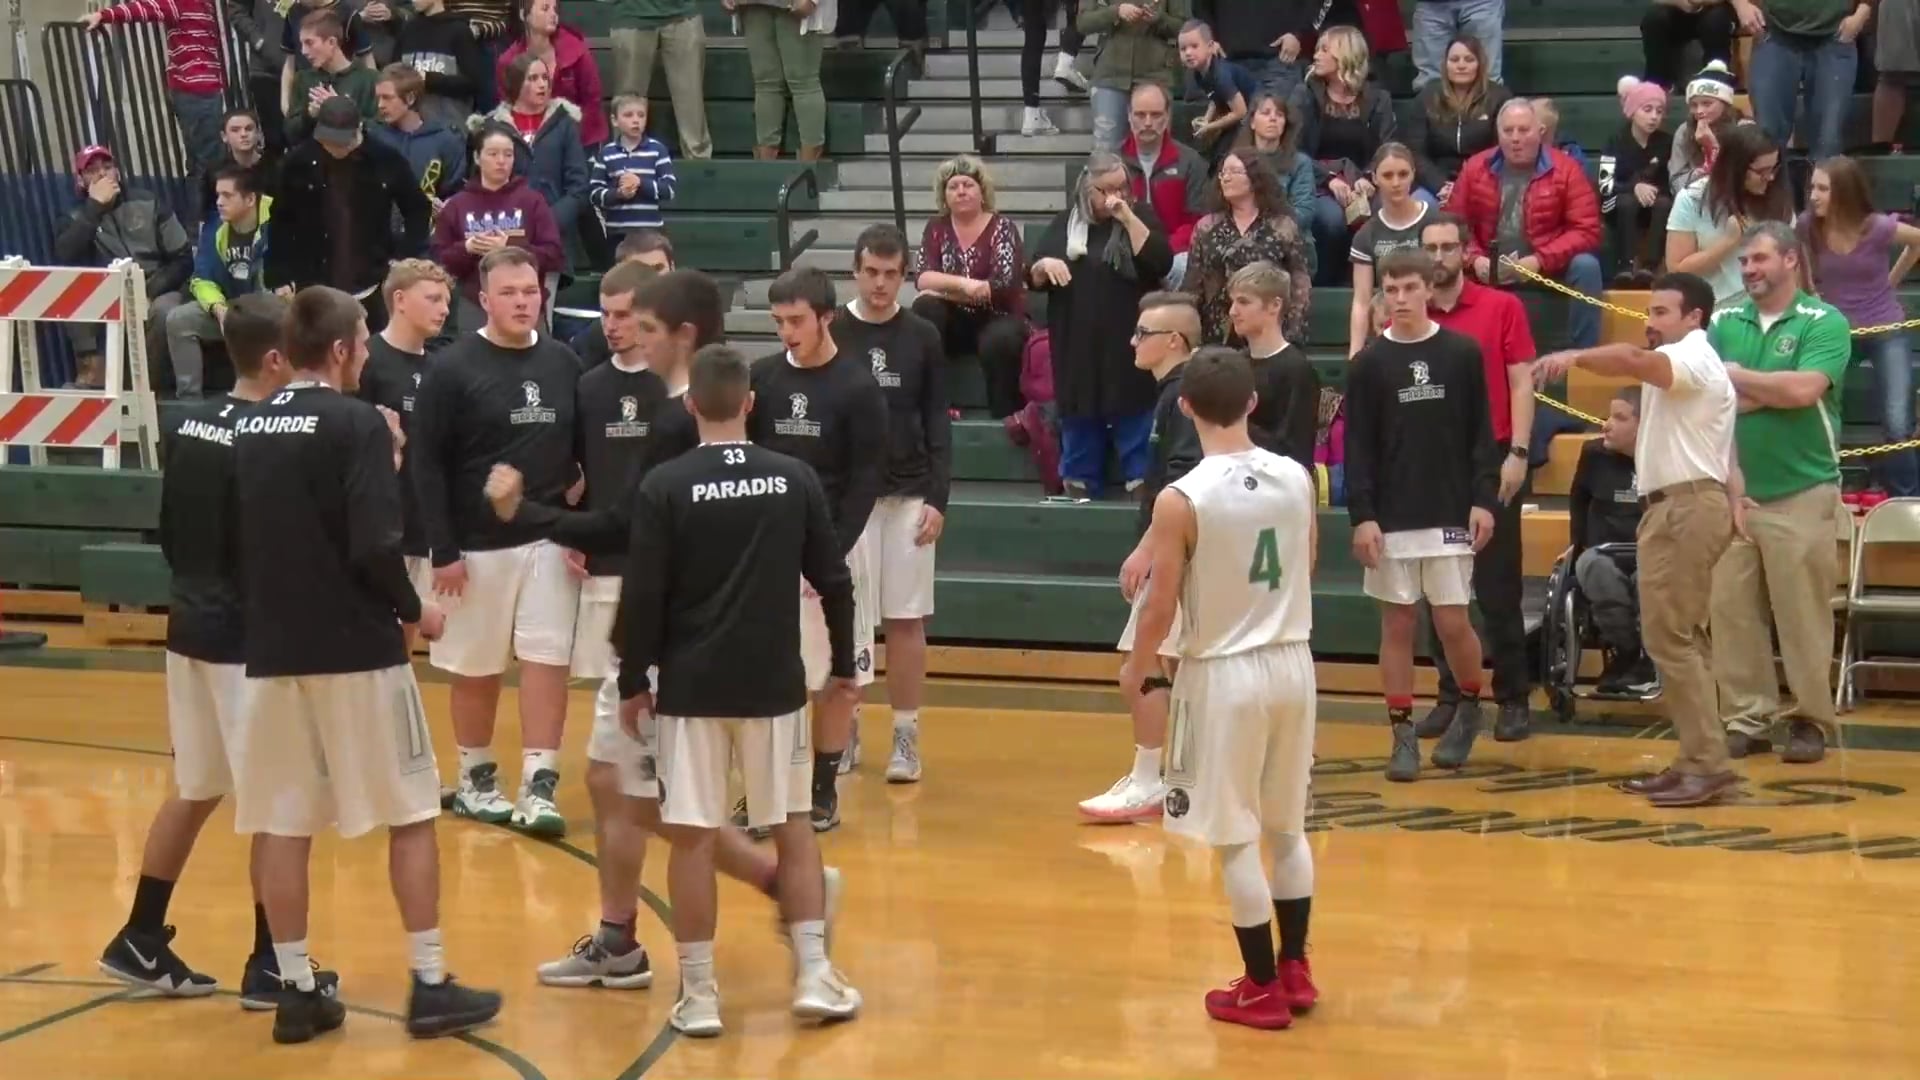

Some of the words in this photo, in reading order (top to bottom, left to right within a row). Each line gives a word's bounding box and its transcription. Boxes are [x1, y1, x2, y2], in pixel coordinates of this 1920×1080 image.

[271, 391, 295, 405] 23
[178, 419, 236, 446] JANDRE
[235, 415, 319, 437] PLOURDE
[723, 448, 746, 465] 33
[692, 476, 788, 502] PARADIS
[1248, 527, 1282, 592] 4
